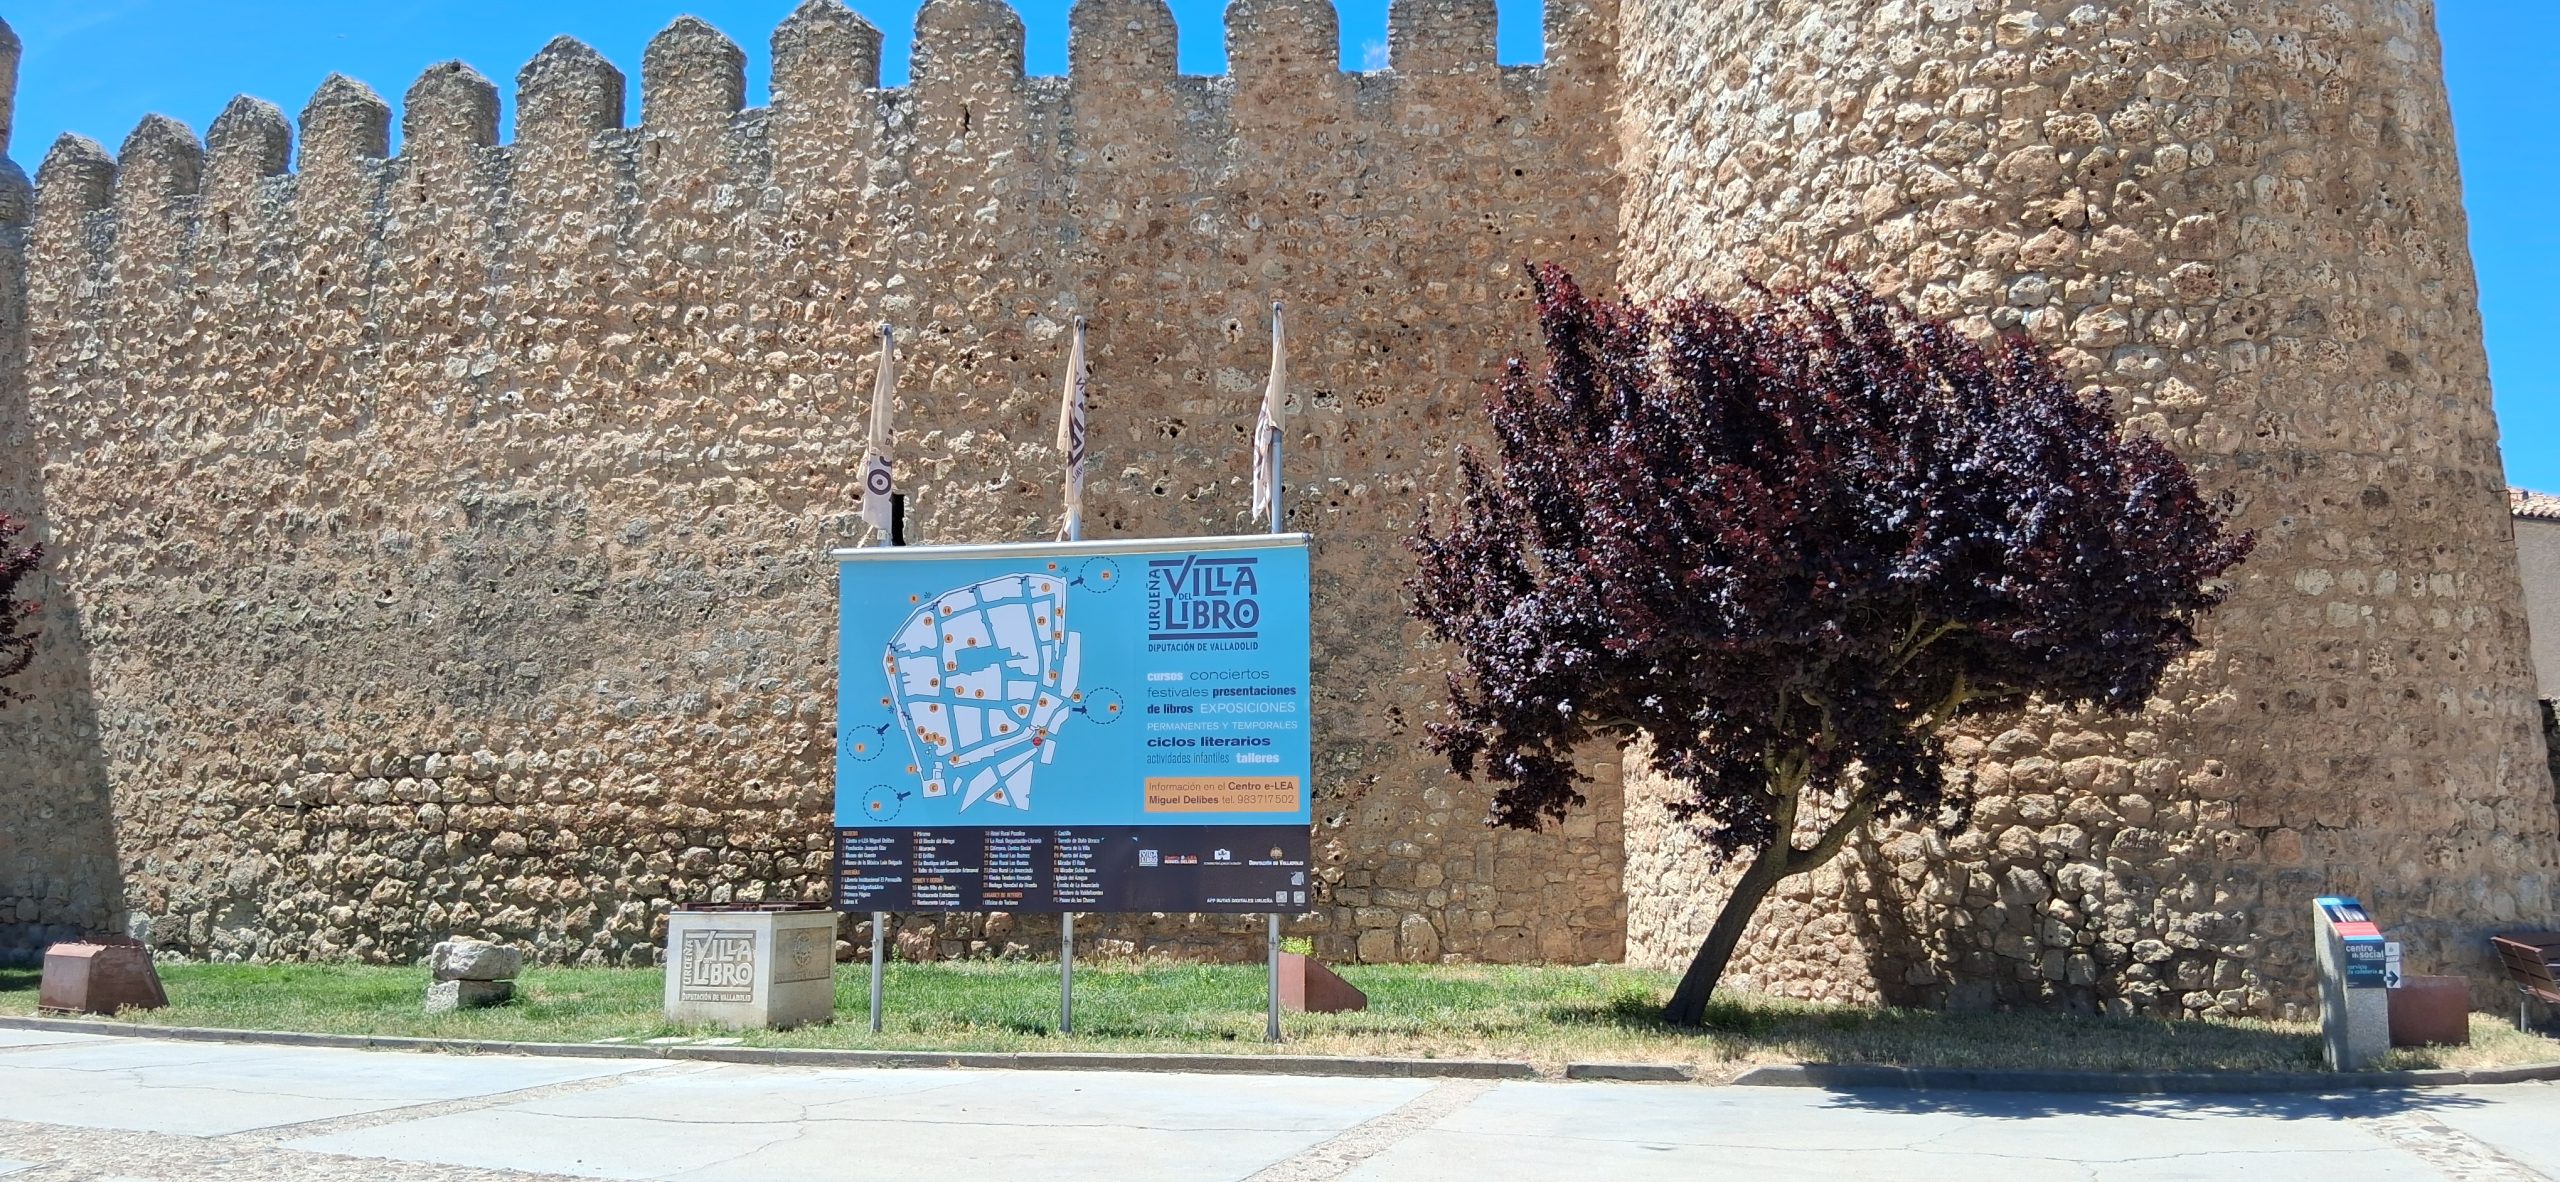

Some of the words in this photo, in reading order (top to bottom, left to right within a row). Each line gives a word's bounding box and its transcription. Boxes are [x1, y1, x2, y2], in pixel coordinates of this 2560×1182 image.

[1162, 554, 1258, 597] VILLA
[1146, 568, 1161, 631] URUEÑA
[1178, 592, 1193, 601] DEL
[1165, 597, 1260, 631] LIBRO
[1148, 642, 1195, 653] DIPUTACIÓN
[1197, 642, 1208, 652] DE
[1209, 641, 1259, 652] VALLADOLID
[1147, 672, 1184, 682] cursos
[1189, 669, 1270, 681] conciertos
[1147, 687, 1209, 698] festivales
[1212, 685, 1297, 699] presentaciones
[1147, 704, 1161, 714] de
[1163, 703, 1194, 714] libros
[1200, 702, 1296, 714] EXPOSICIONES
[1147, 722, 1219, 731] PERMANENTES
[1221, 721, 1229, 730] Y
[1231, 721, 1298, 730] TEMPORALES
[1147, 736, 1196, 748] ciclos
[1200, 736, 1271, 747] literarios
[1146, 753, 1191, 764] actividades
[1193, 752, 1230, 764] infantiles
[1236, 752, 1280, 763] talleres
[1149, 782, 1201, 791] Información
[1203, 783, 1215, 791] en
[1217, 782, 1226, 791] el
[1227, 782, 1262, 791] Centro
[1264, 781, 1294, 791] e-LEA
[1149, 795, 1181, 806] Miguel
[1183, 795, 1219, 805] Delibes
[693, 930, 753, 962] VILLA
[2345, 944, 2374, 952] centro
[2359, 949, 2384, 959] social
[683, 939, 694, 985] URUEÑA
[692, 959, 753, 986] LIBRO
[712, 993, 720, 1001] DE
